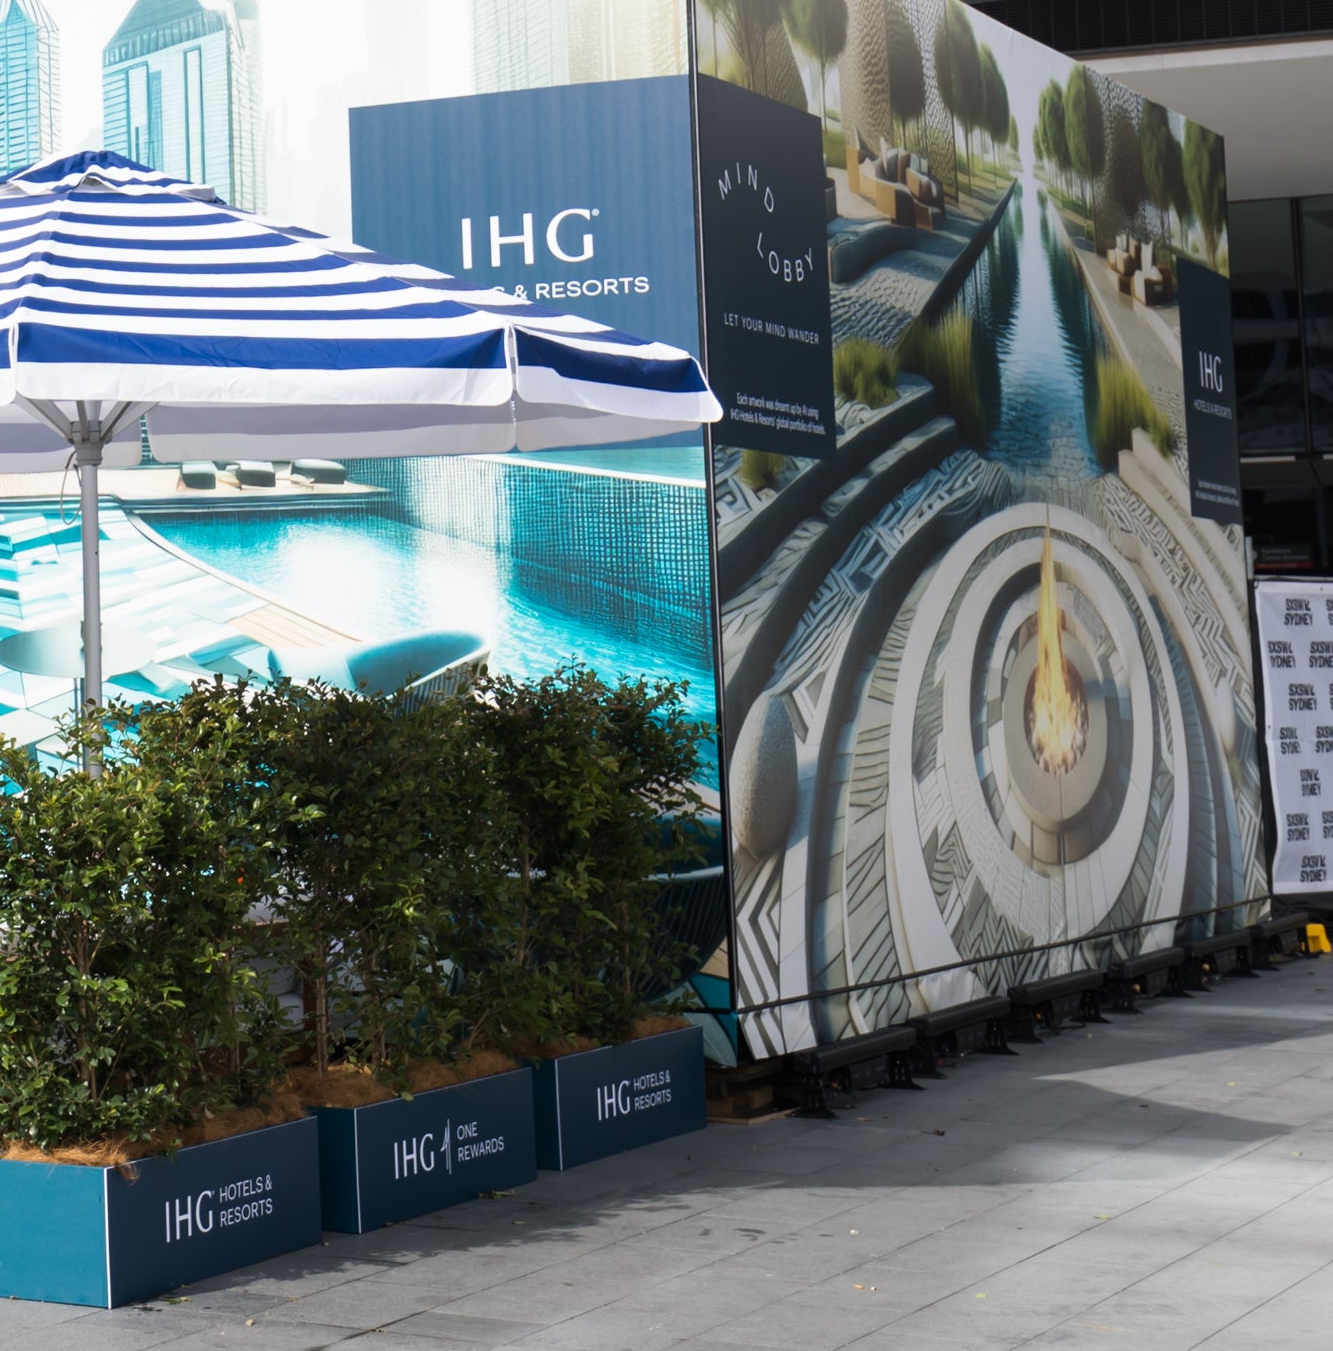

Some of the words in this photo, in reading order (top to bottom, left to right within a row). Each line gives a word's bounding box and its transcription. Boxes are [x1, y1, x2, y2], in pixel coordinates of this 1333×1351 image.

[718, 162, 774, 213] MIND
[461, 208, 595, 270] IHG
[757, 231, 814, 282] LOBBY
[535, 276, 650, 299] RESORTS
[724, 312, 738, 327] LET
[741, 315, 763, 333] YOUR
[765, 321, 786, 338] MIND
[787, 326, 820, 346] WANDER
[1199, 350, 1223, 393] IHG
[597, 1080, 631, 1122] IHG
[633, 1071, 665, 1091] HOTELS
[665, 1069, 671, 1083] &
[634, 1088, 672, 1111] RESORTS
[394, 1133, 435, 1180] IHG
[456, 1121, 478, 1141] ONE
[457, 1136, 505, 1162] REWARDS
[165, 1190, 214, 1243] IHG
[219, 1176, 264, 1204] HOTELS
[265, 1174, 273, 1191] &
[219, 1197, 273, 1228] RESORTS
